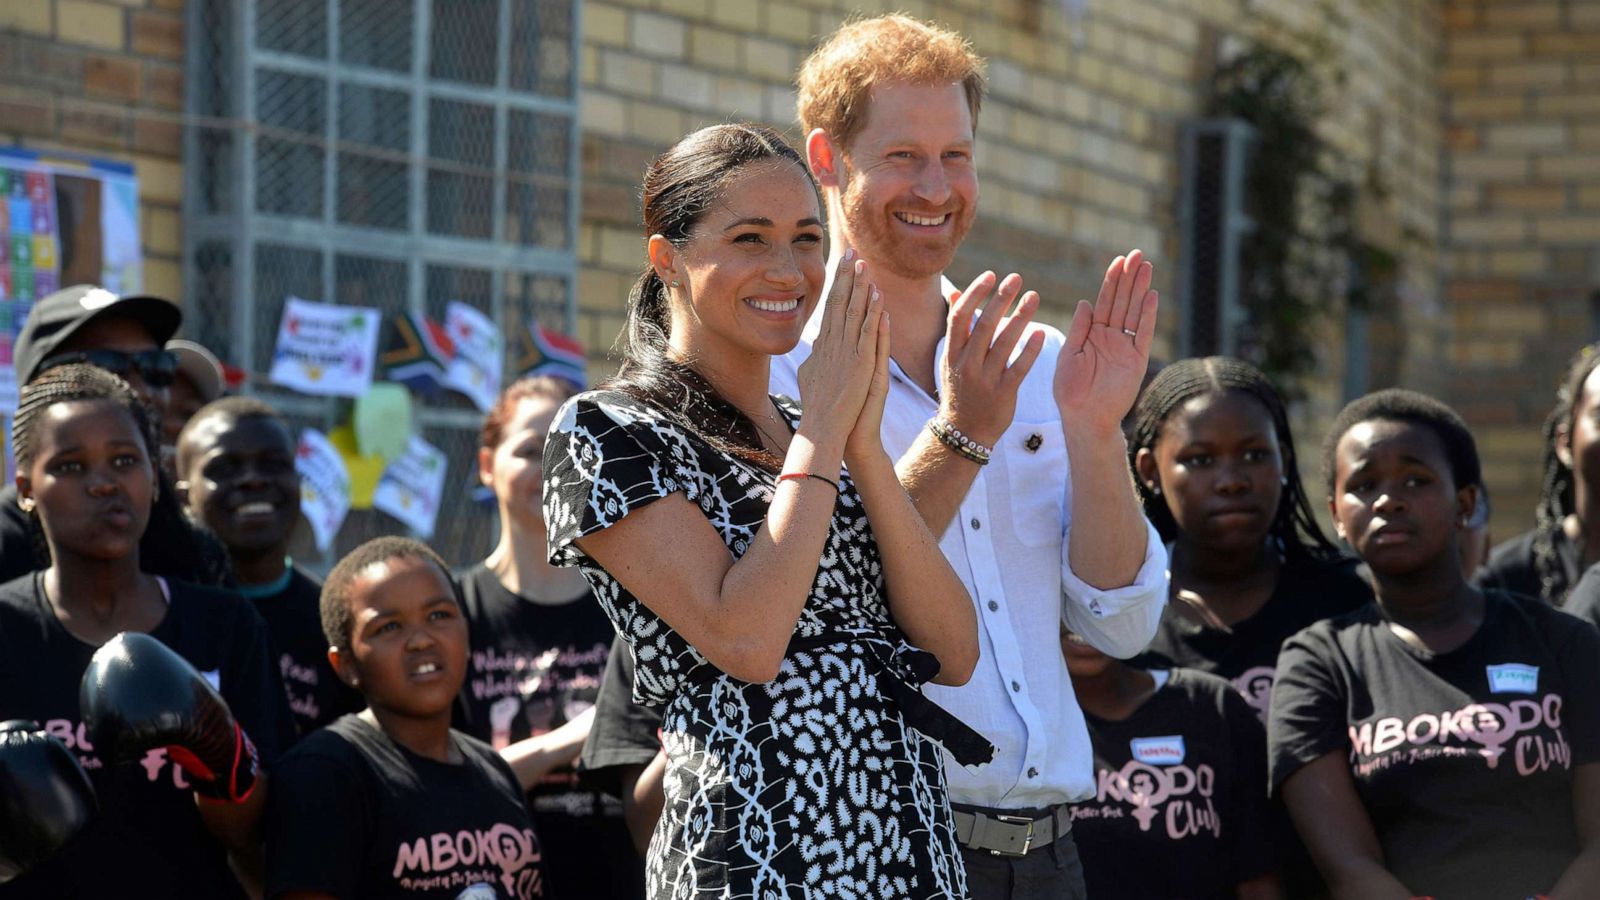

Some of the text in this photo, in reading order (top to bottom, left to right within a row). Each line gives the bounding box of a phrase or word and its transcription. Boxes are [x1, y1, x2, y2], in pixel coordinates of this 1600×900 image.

[1348, 693, 1562, 757] MBOKODO
[1515, 729, 1571, 776] Club
[1166, 798, 1221, 839] Club
